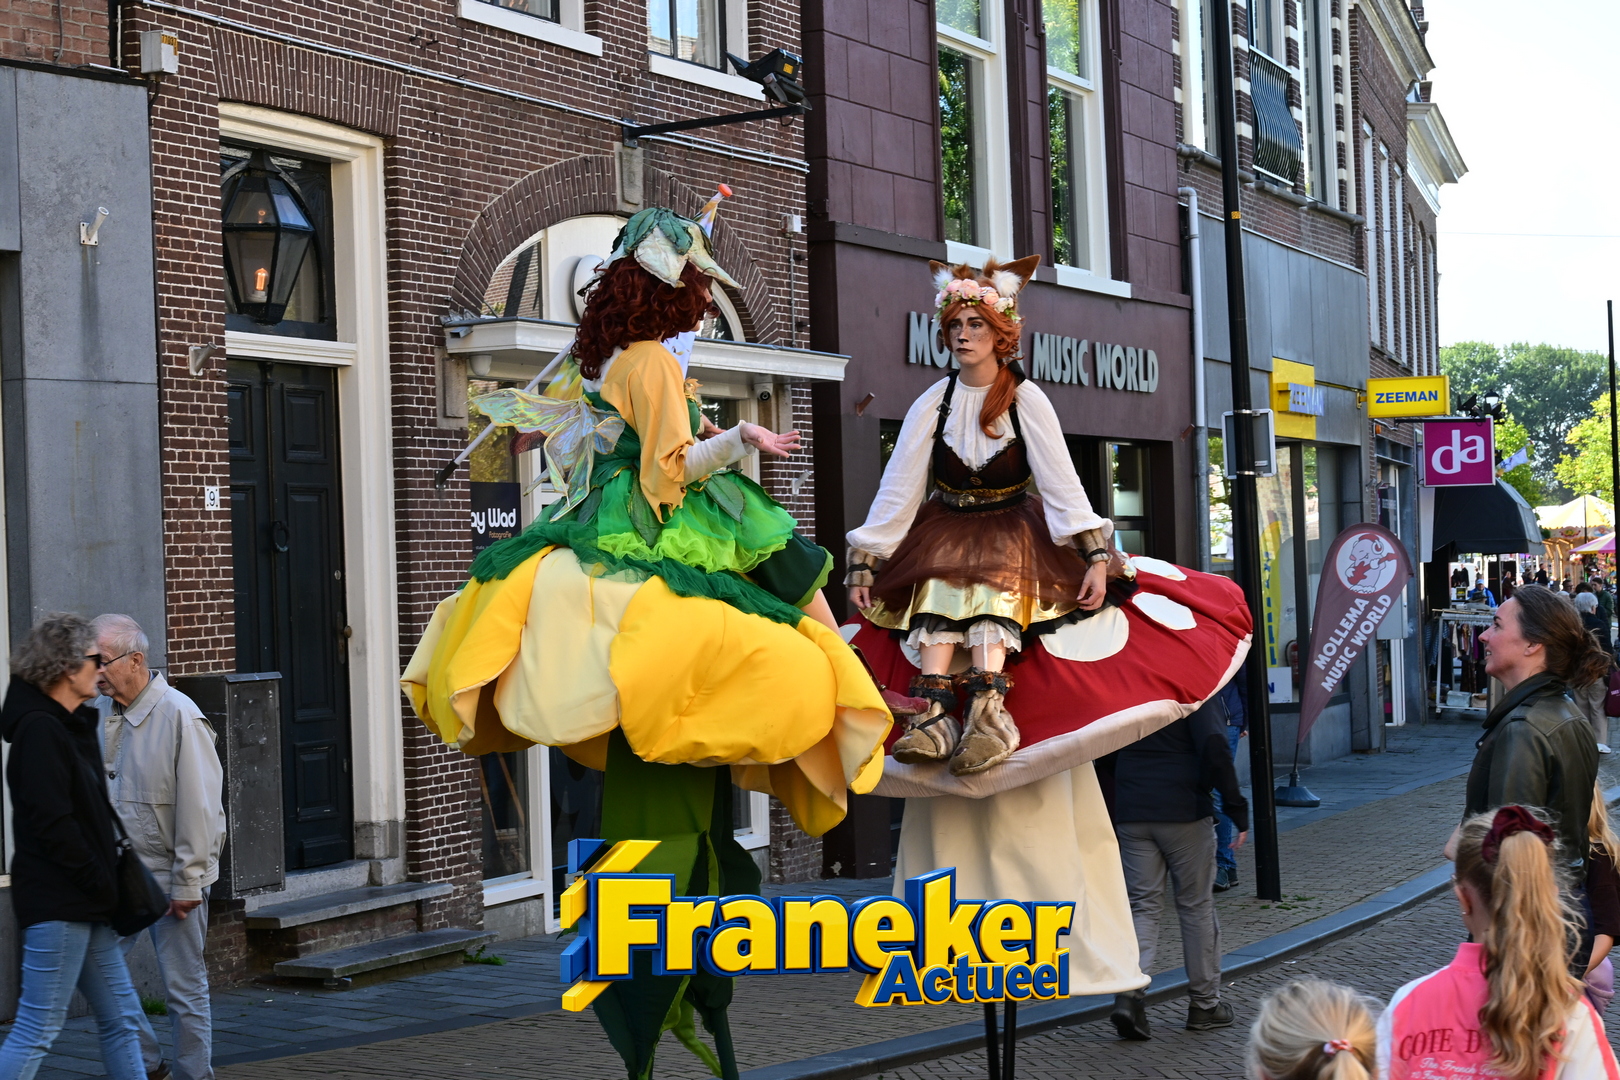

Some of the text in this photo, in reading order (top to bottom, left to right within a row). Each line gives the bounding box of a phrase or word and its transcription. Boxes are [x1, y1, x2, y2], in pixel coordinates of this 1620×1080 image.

[1032, 332, 1089, 387] MUSIC
[1095, 341, 1159, 393] WORLD
[1375, 390, 1438, 404] ZEEMAN
[1431, 429, 1485, 475] da
[209, 491, 216, 507] 9
[471, 508, 516, 534] ay Wad
[1313, 597, 1370, 671] MOLLEMA
[1320, 594, 1392, 693] MUSIC WORLD
[1399, 1028, 1453, 1061] COTE
[1419, 1057, 1439, 1069] The
[1440, 1060, 1477, 1074] French
